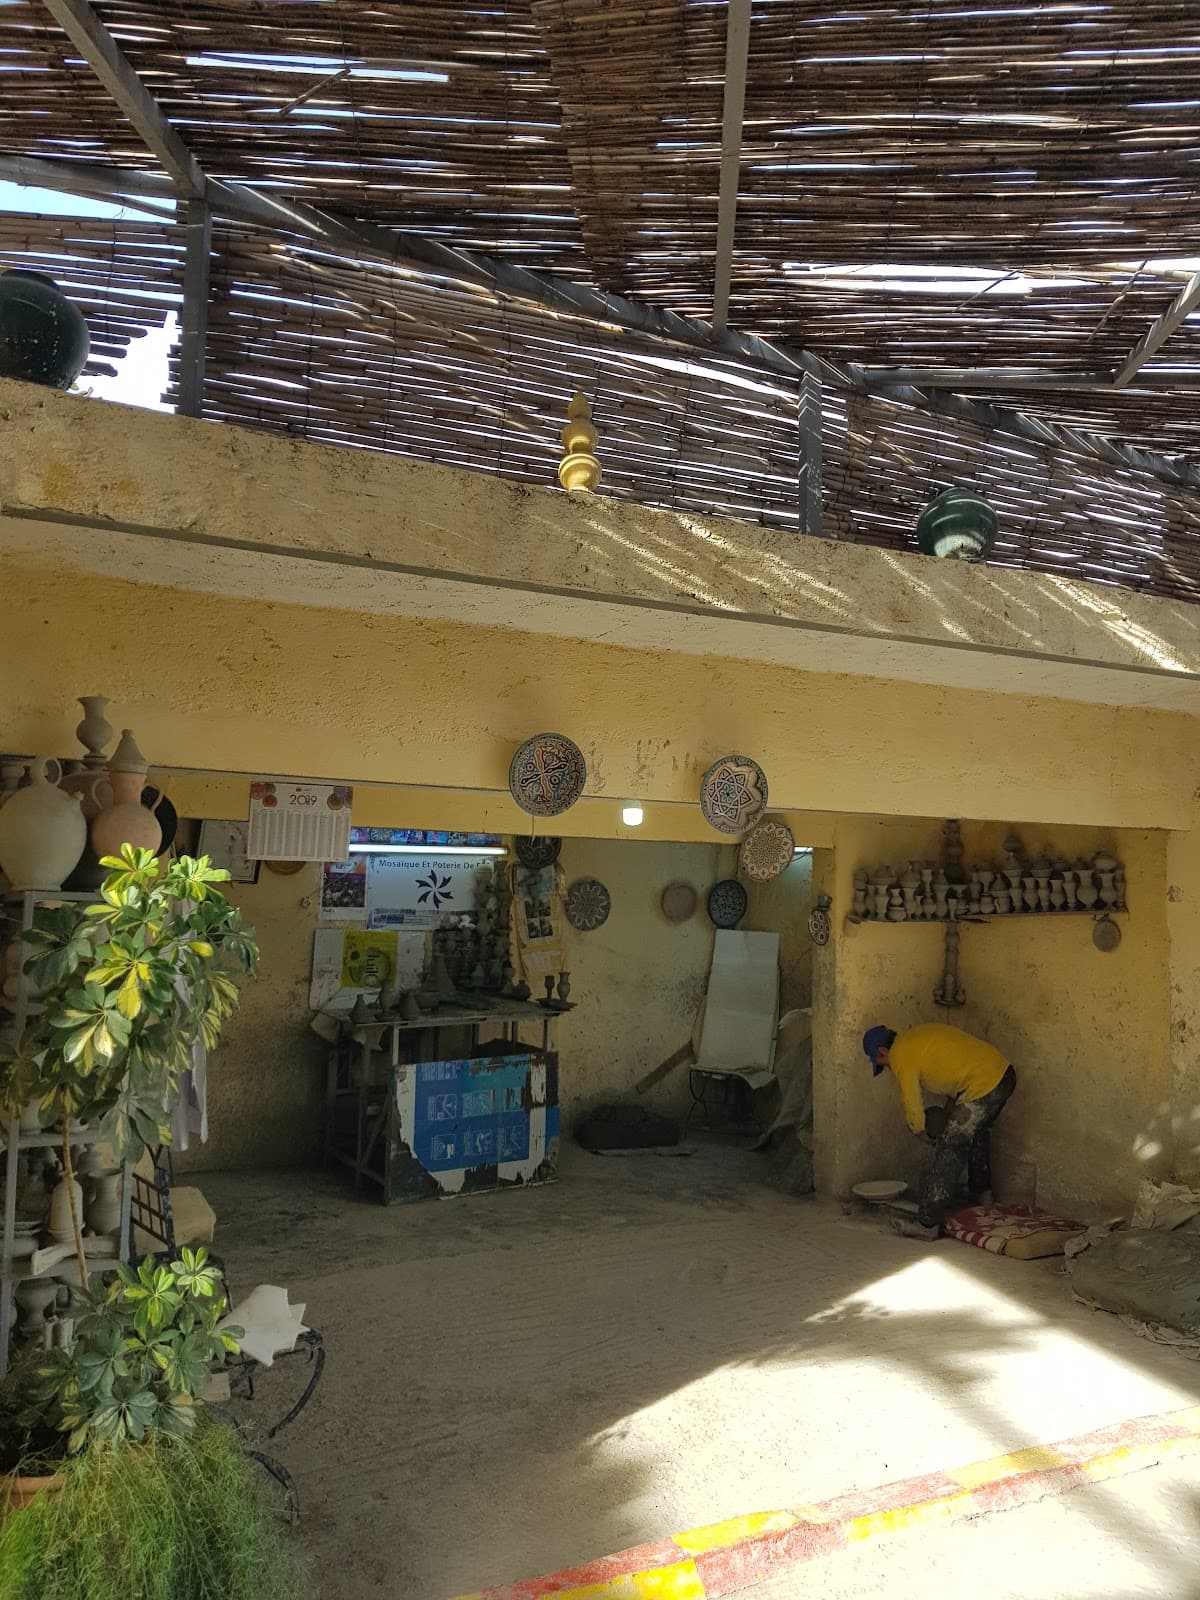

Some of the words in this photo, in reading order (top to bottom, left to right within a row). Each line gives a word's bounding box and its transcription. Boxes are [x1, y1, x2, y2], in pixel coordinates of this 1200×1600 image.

[288, 794, 318, 806] 2019
[422, 860, 432, 869] Et
[433, 860, 463, 870] Poterie
[463, 861, 475, 870] De
